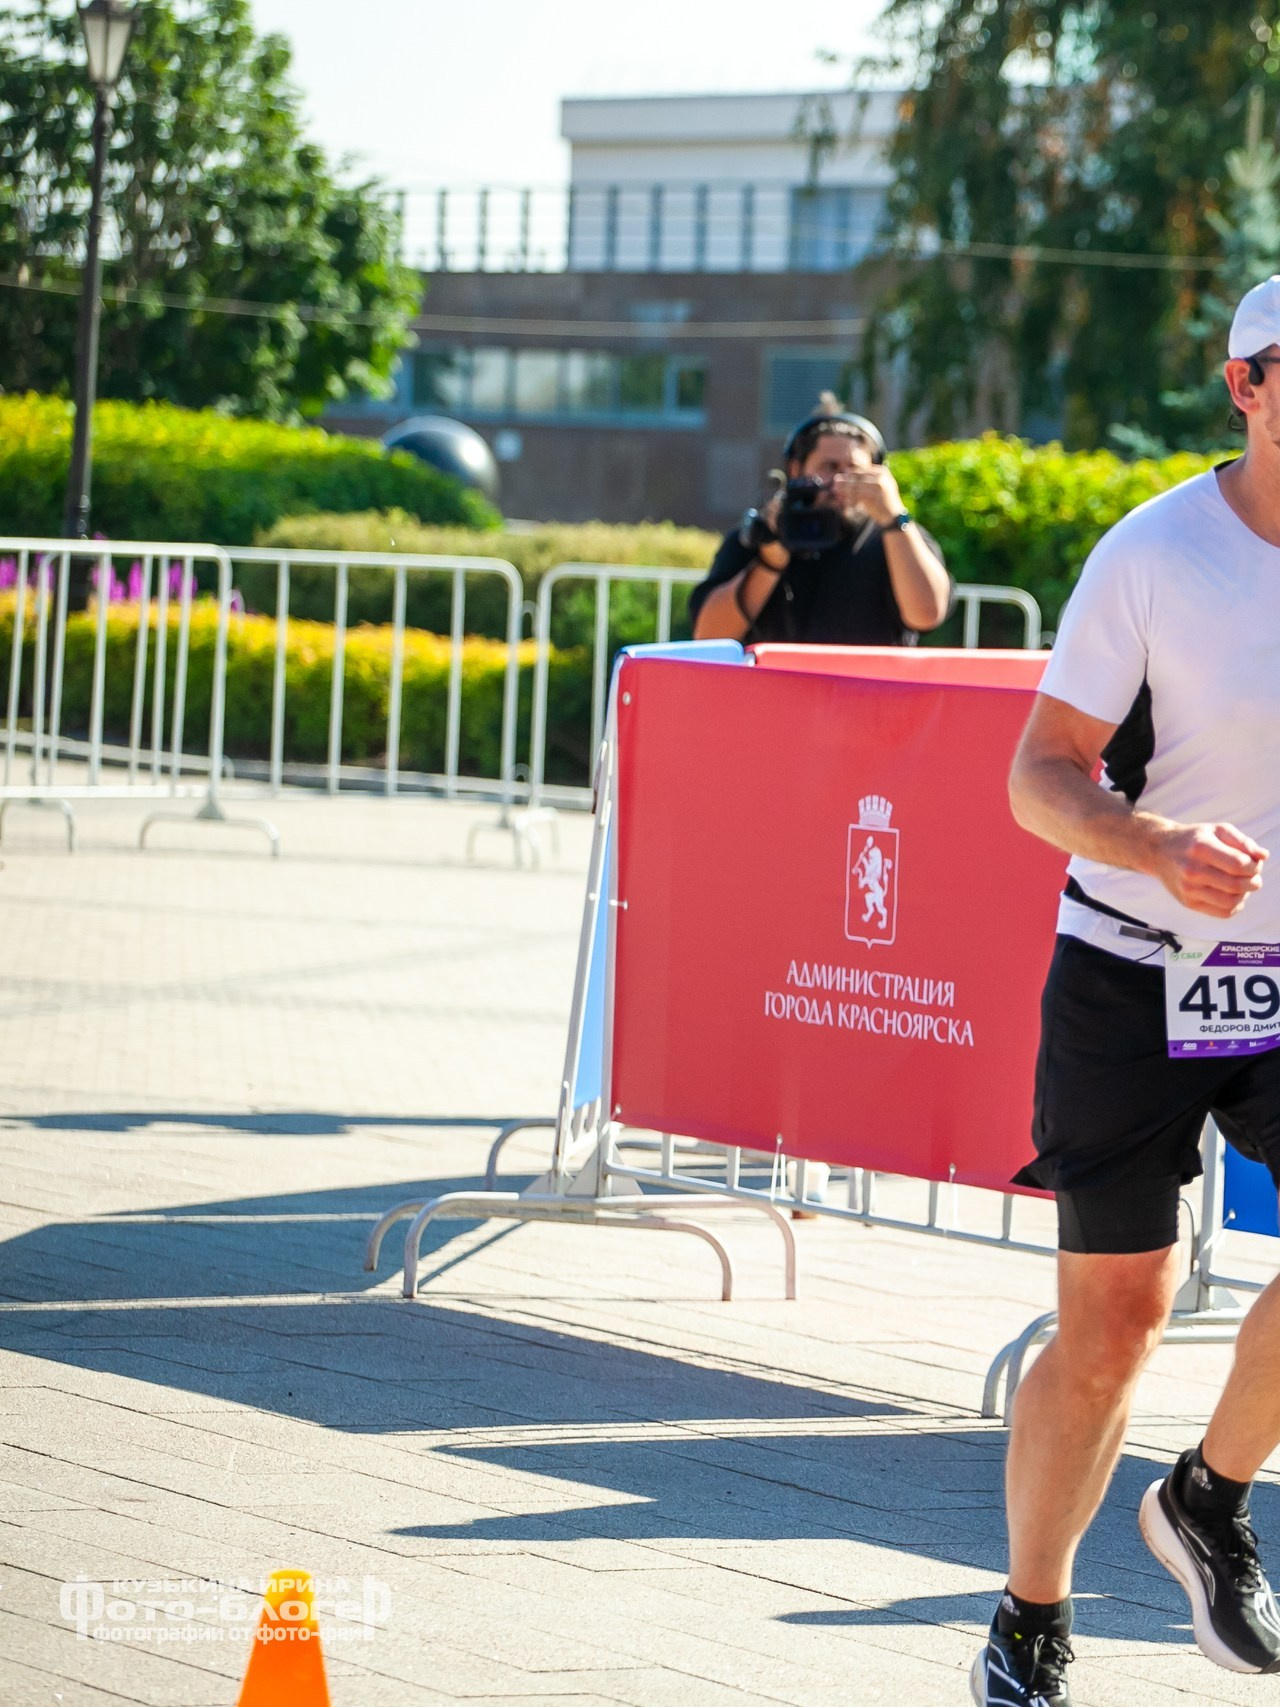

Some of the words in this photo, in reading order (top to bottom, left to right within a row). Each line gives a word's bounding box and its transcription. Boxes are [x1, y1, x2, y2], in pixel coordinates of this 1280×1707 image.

[1221, 945, 1280, 953] КРАСНОЯРСКИЕ
[786, 959, 955, 1008] АДМИНИСТРАЦИЯ
[764, 990, 834, 1027] ГОРОДА
[837, 1002, 975, 1047] КРАСНОЯРСКА
[1199, 1024, 1251, 1034] ФЕДОРОВ
